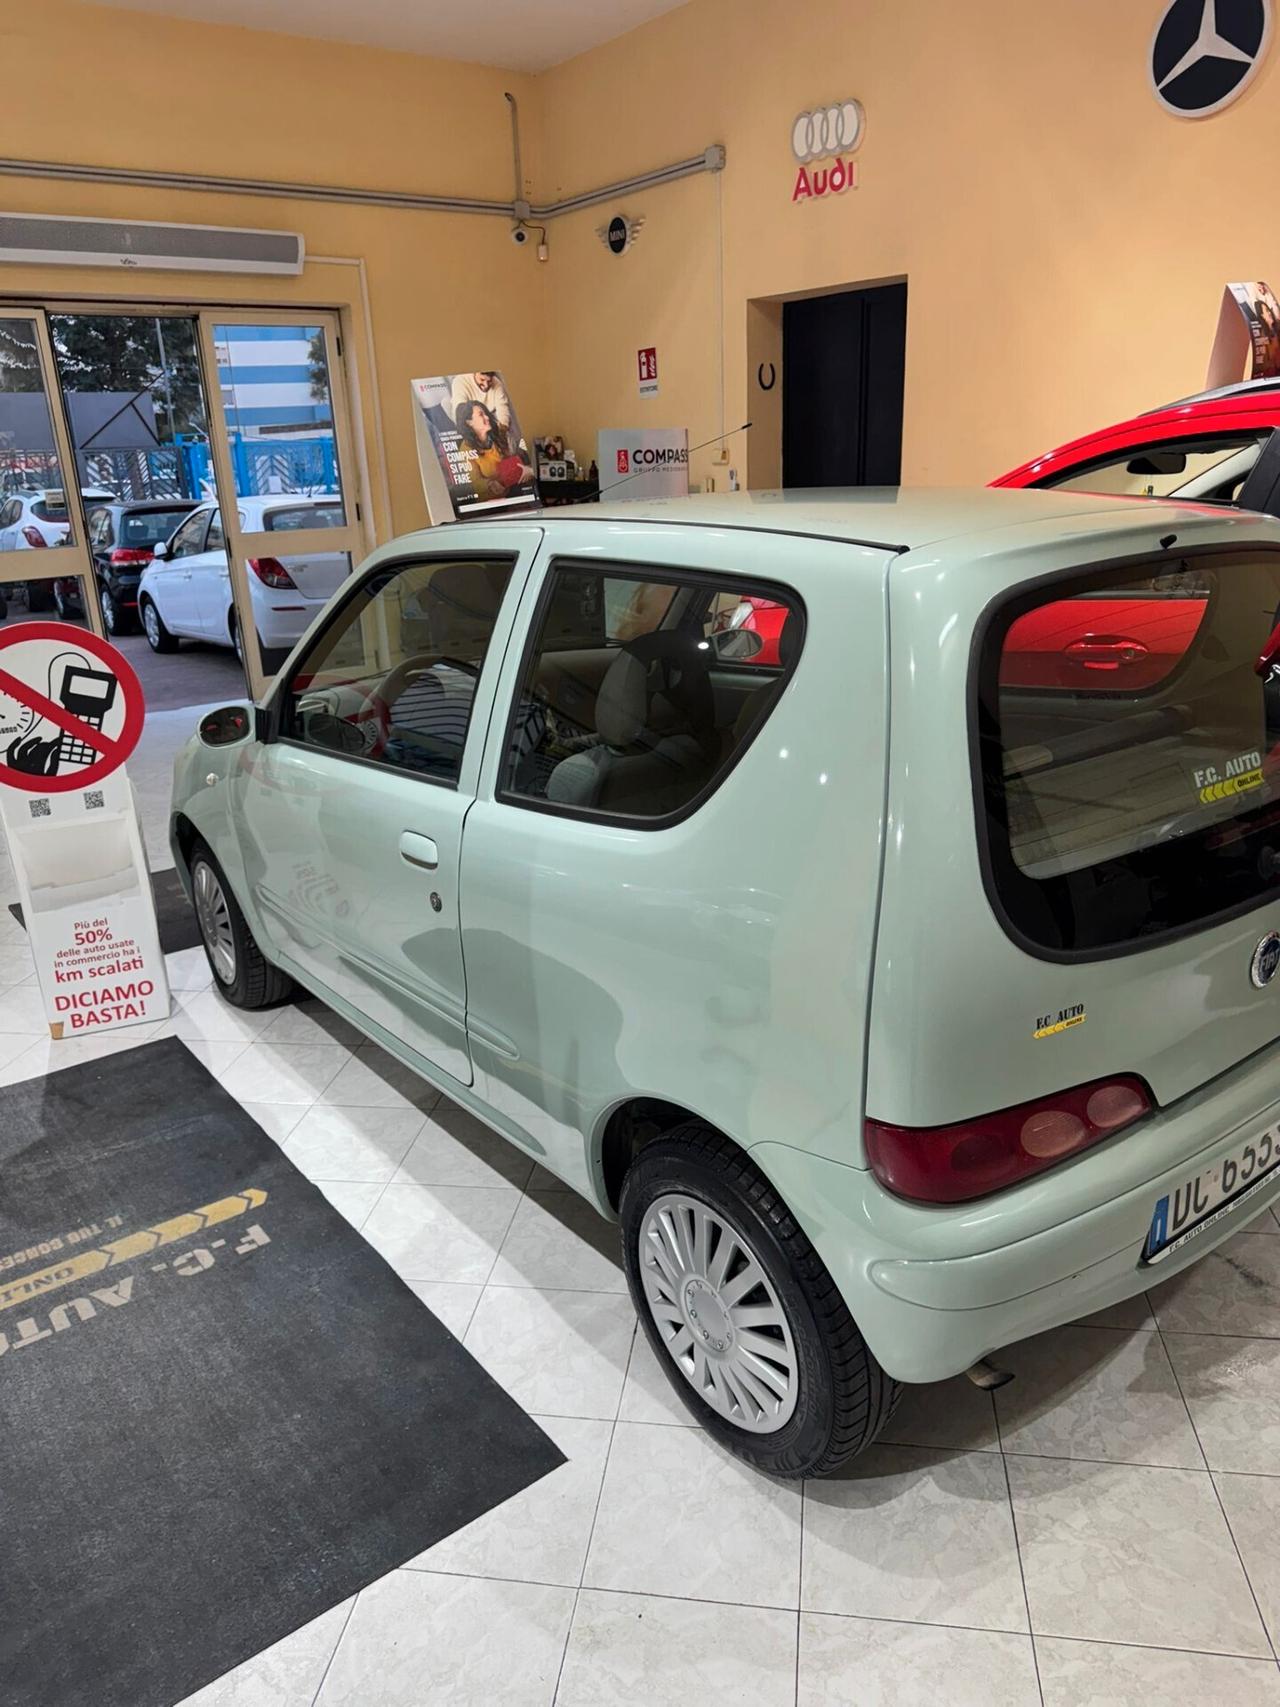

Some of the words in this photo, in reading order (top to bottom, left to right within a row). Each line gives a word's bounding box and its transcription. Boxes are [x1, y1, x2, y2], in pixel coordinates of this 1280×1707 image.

[792, 157, 854, 202] Audi
[609, 229, 626, 241] MINI
[443, 441, 458, 452] CON
[446, 449, 479, 462] COMPASS
[632, 448, 688, 464] COMPASS
[450, 463, 459, 474] SI
[453, 473, 472, 485] FARE
[1225, 751, 1262, 777] AUTO
[74, 921, 91, 930] Più
[92, 917, 108, 927] del
[74, 927, 113, 945] 50%
[56, 948, 81, 958] delle
[84, 945, 105, 954] auto
[108, 939, 135, 950] usate
[66, 951, 120, 967] commercio
[122, 948, 135, 956] ha
[55, 970, 83, 983] km
[88, 956, 144, 978] scalati
[54, 980, 154, 1011] DICIAMO
[70, 1000, 146, 1029] BASTA!
[1057, 1003, 1084, 1023] AUTO
[0, 1237, 65, 1272] CONCE
[0, 1267, 74, 1301] ONLI
[0, 1275, 134, 1357] AUT
